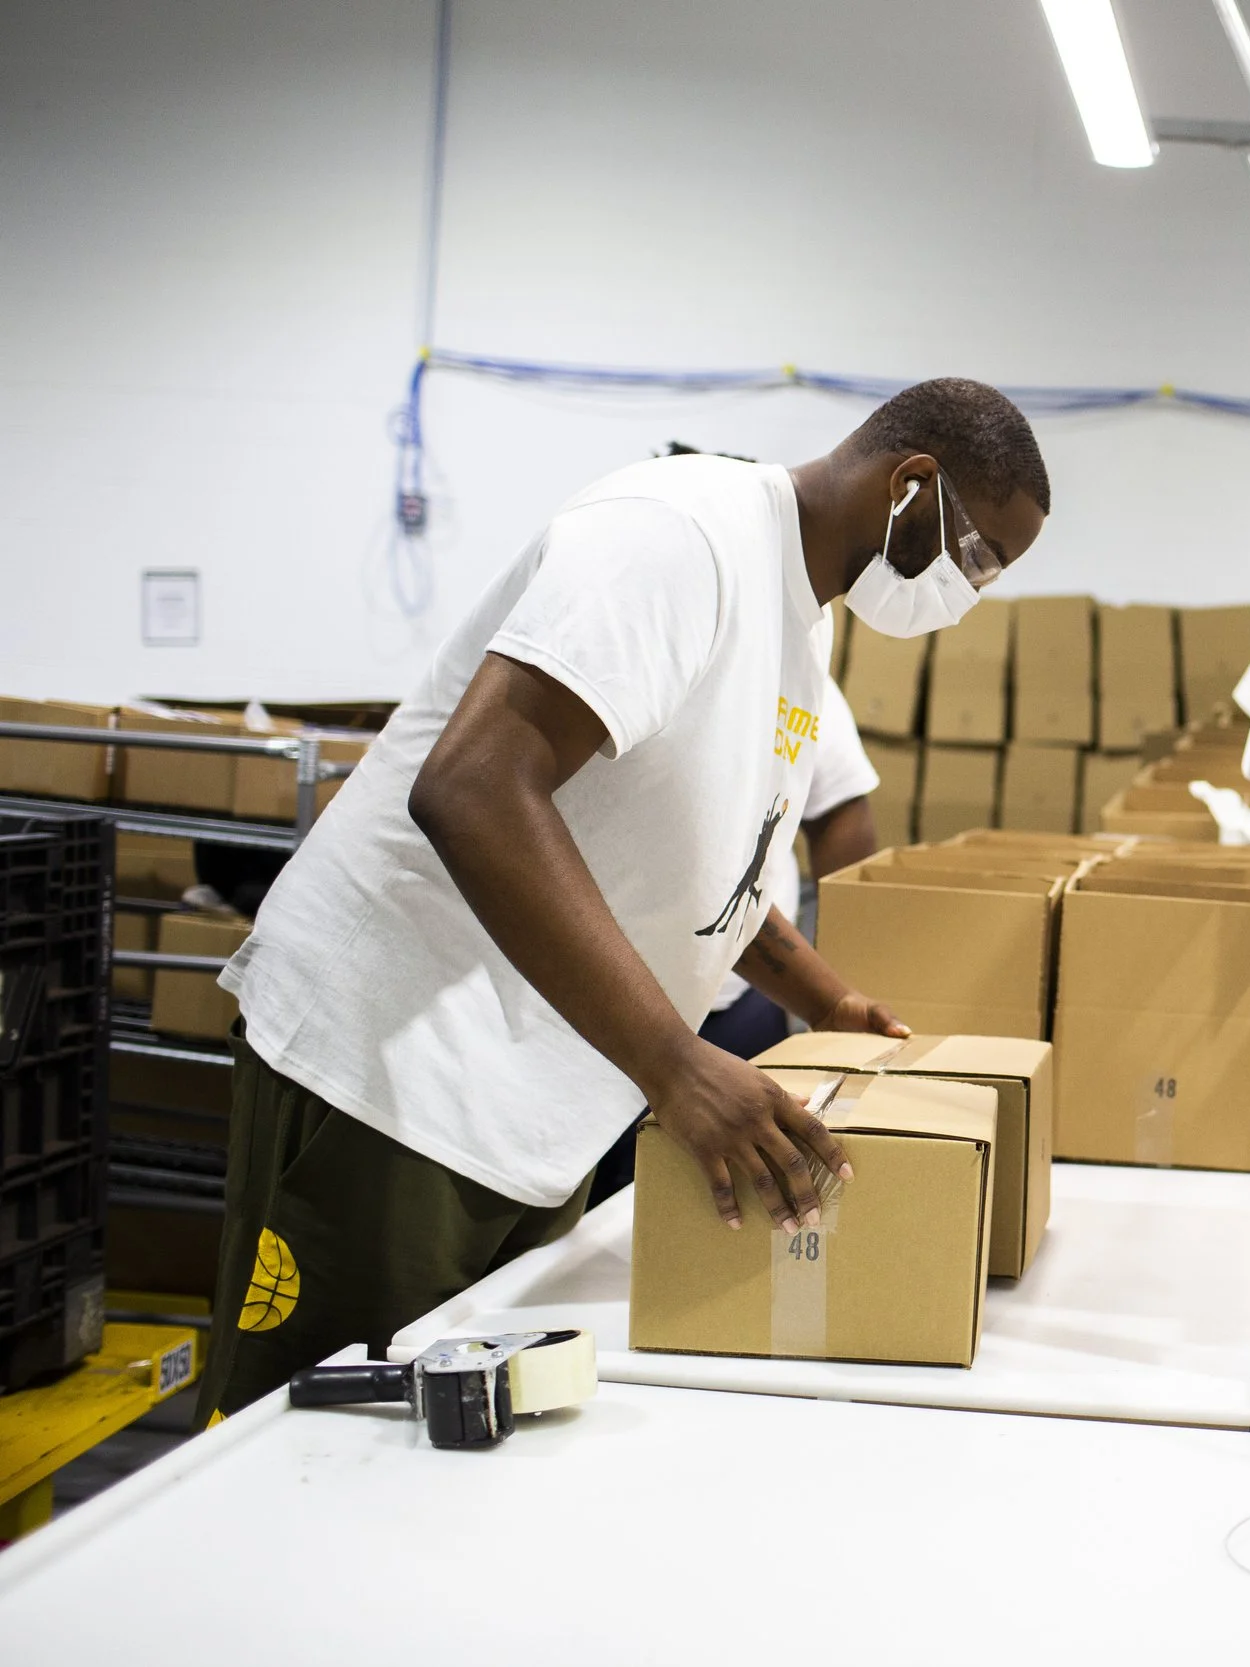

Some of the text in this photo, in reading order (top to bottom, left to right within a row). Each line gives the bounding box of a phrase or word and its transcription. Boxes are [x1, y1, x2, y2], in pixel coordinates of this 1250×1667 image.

[777, 695, 819, 742] AME
[1154, 1077, 1177, 1099] 48
[788, 1231, 820, 1262] 48
